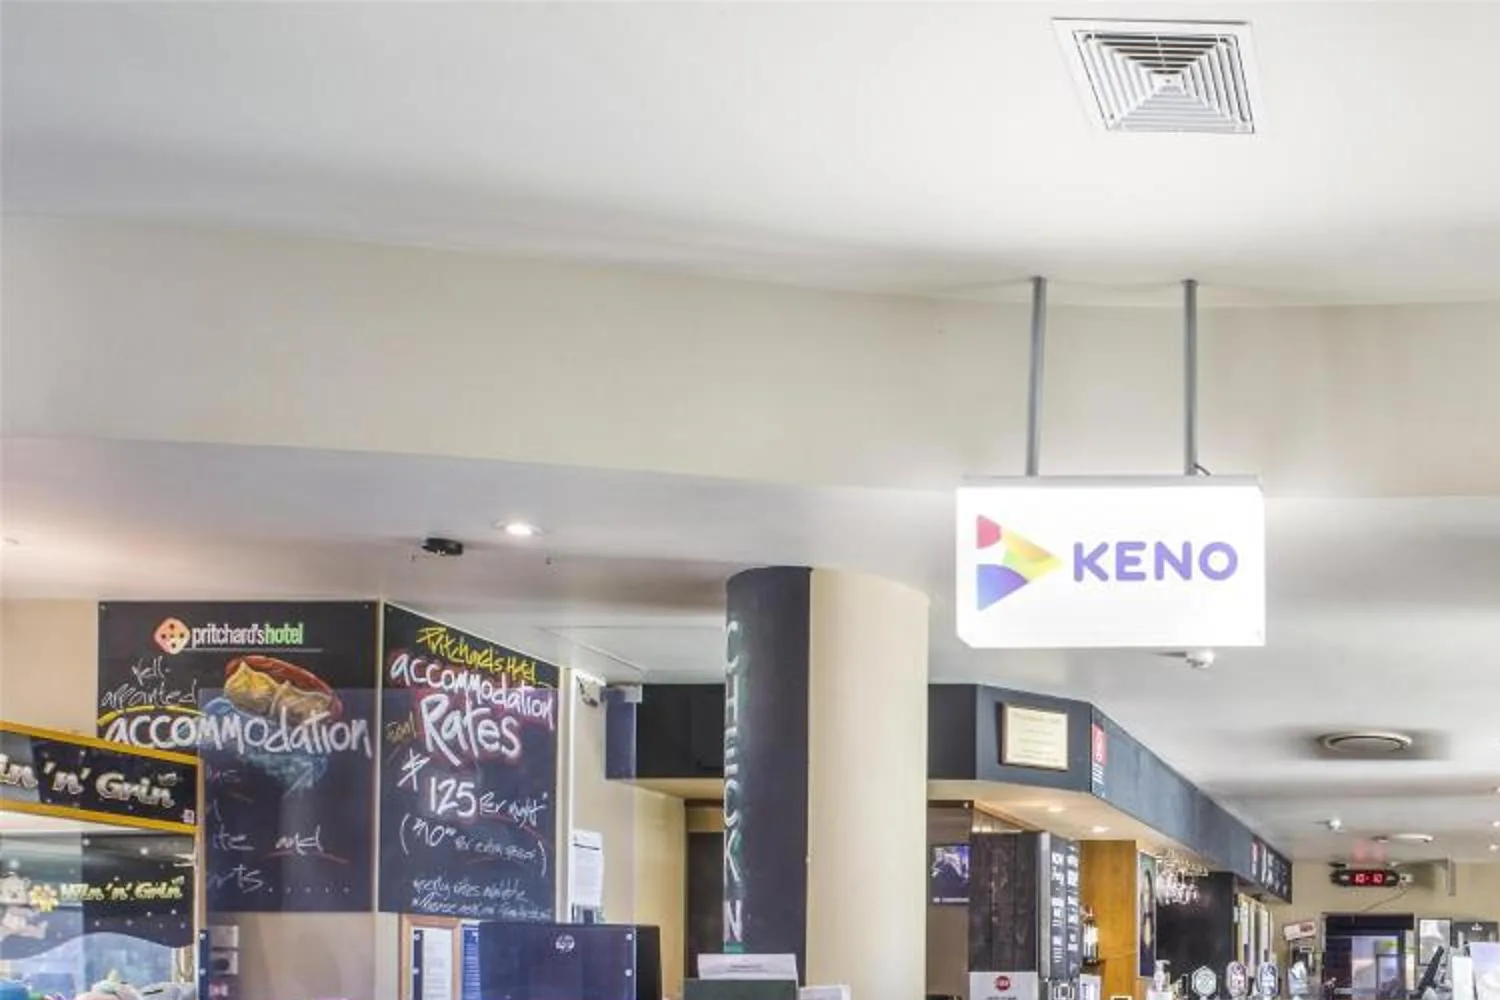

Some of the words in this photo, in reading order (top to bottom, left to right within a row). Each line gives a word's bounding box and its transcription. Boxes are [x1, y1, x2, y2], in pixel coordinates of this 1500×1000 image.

[1073, 541, 1238, 582] KENO
[420, 693, 522, 767] Rates
[95, 772, 175, 809] Grin
